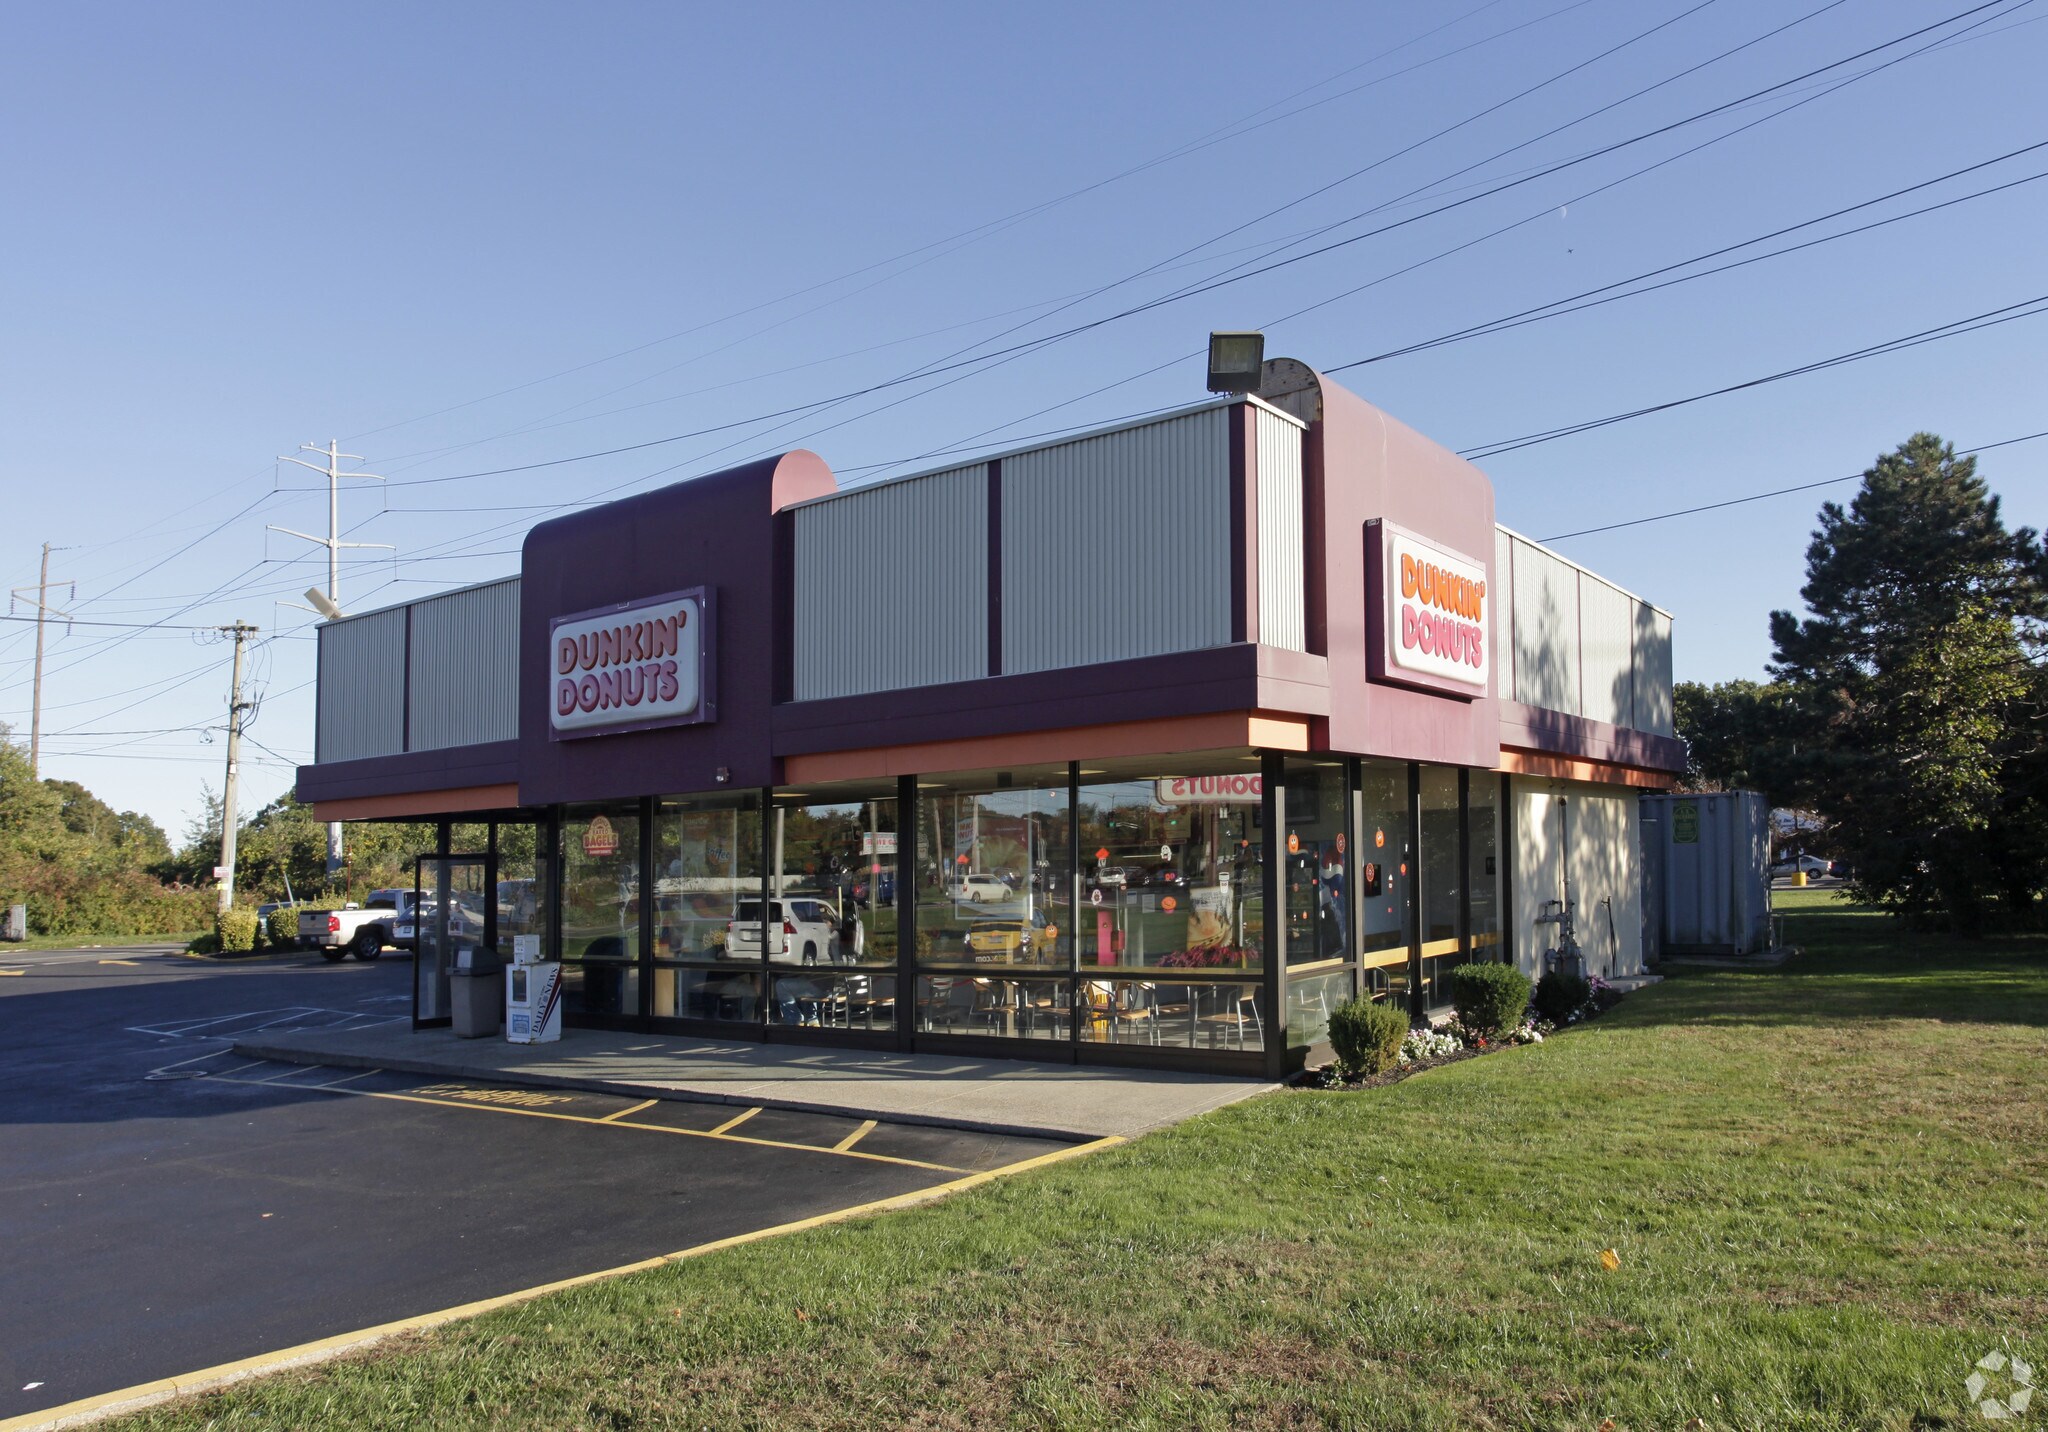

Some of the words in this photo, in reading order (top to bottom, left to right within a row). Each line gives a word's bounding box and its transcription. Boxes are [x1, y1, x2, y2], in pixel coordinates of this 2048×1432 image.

[1401, 552, 1486, 623] DUNKIN'
[557, 609, 687, 675] DUNKIN'
[1402, 603, 1483, 669] DONUTS
[557, 659, 679, 717] DONUTS
[584, 834, 617, 847] BAGELS
[532, 1004, 548, 1033] DAILY
[545, 967, 558, 996] NEWS
